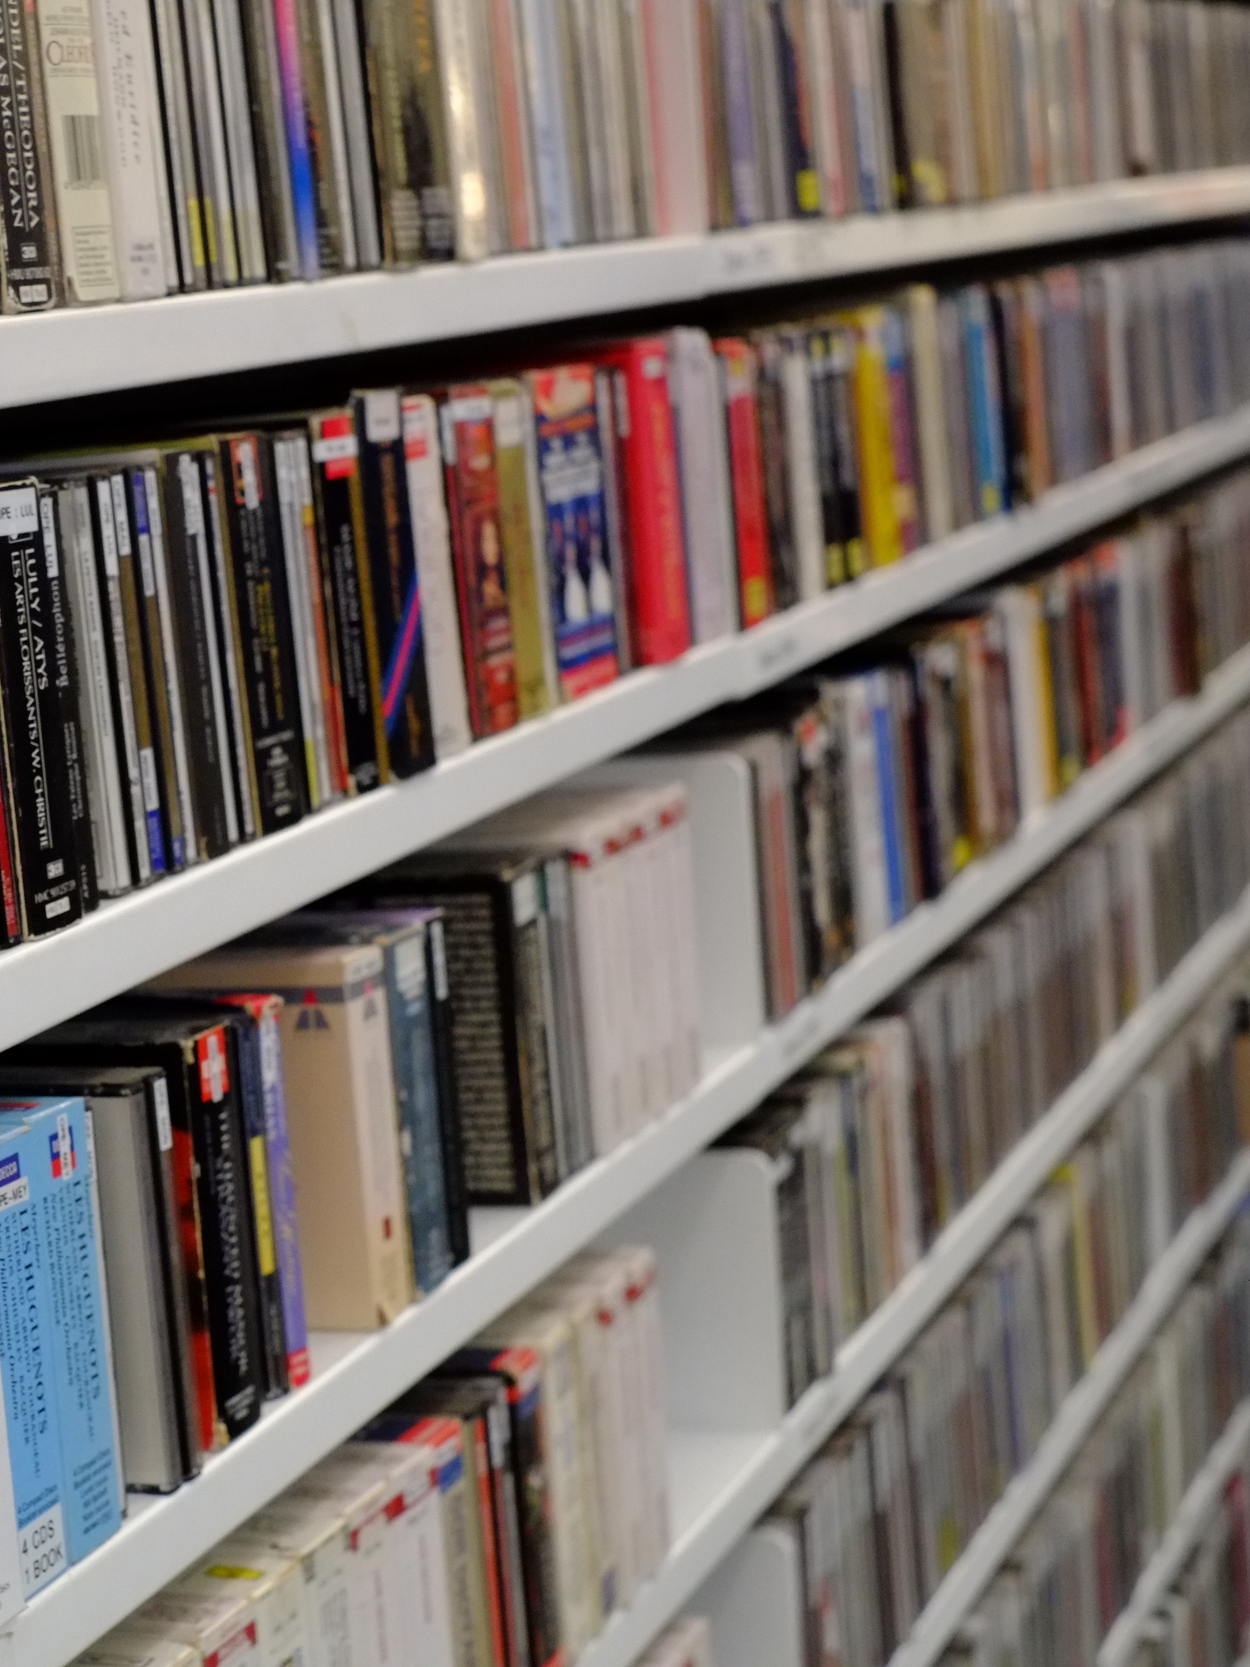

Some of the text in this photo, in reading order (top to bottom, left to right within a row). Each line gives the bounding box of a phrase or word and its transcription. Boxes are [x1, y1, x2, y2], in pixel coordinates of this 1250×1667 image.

[11, 551, 22, 578] LES
[14, 581, 26, 625] ARTS
[33, 775, 50, 850] CHRISTIE
[19, 1209, 49, 1435] LES HUGUENOTS
[21, 1519, 55, 1556] 4 CDS
